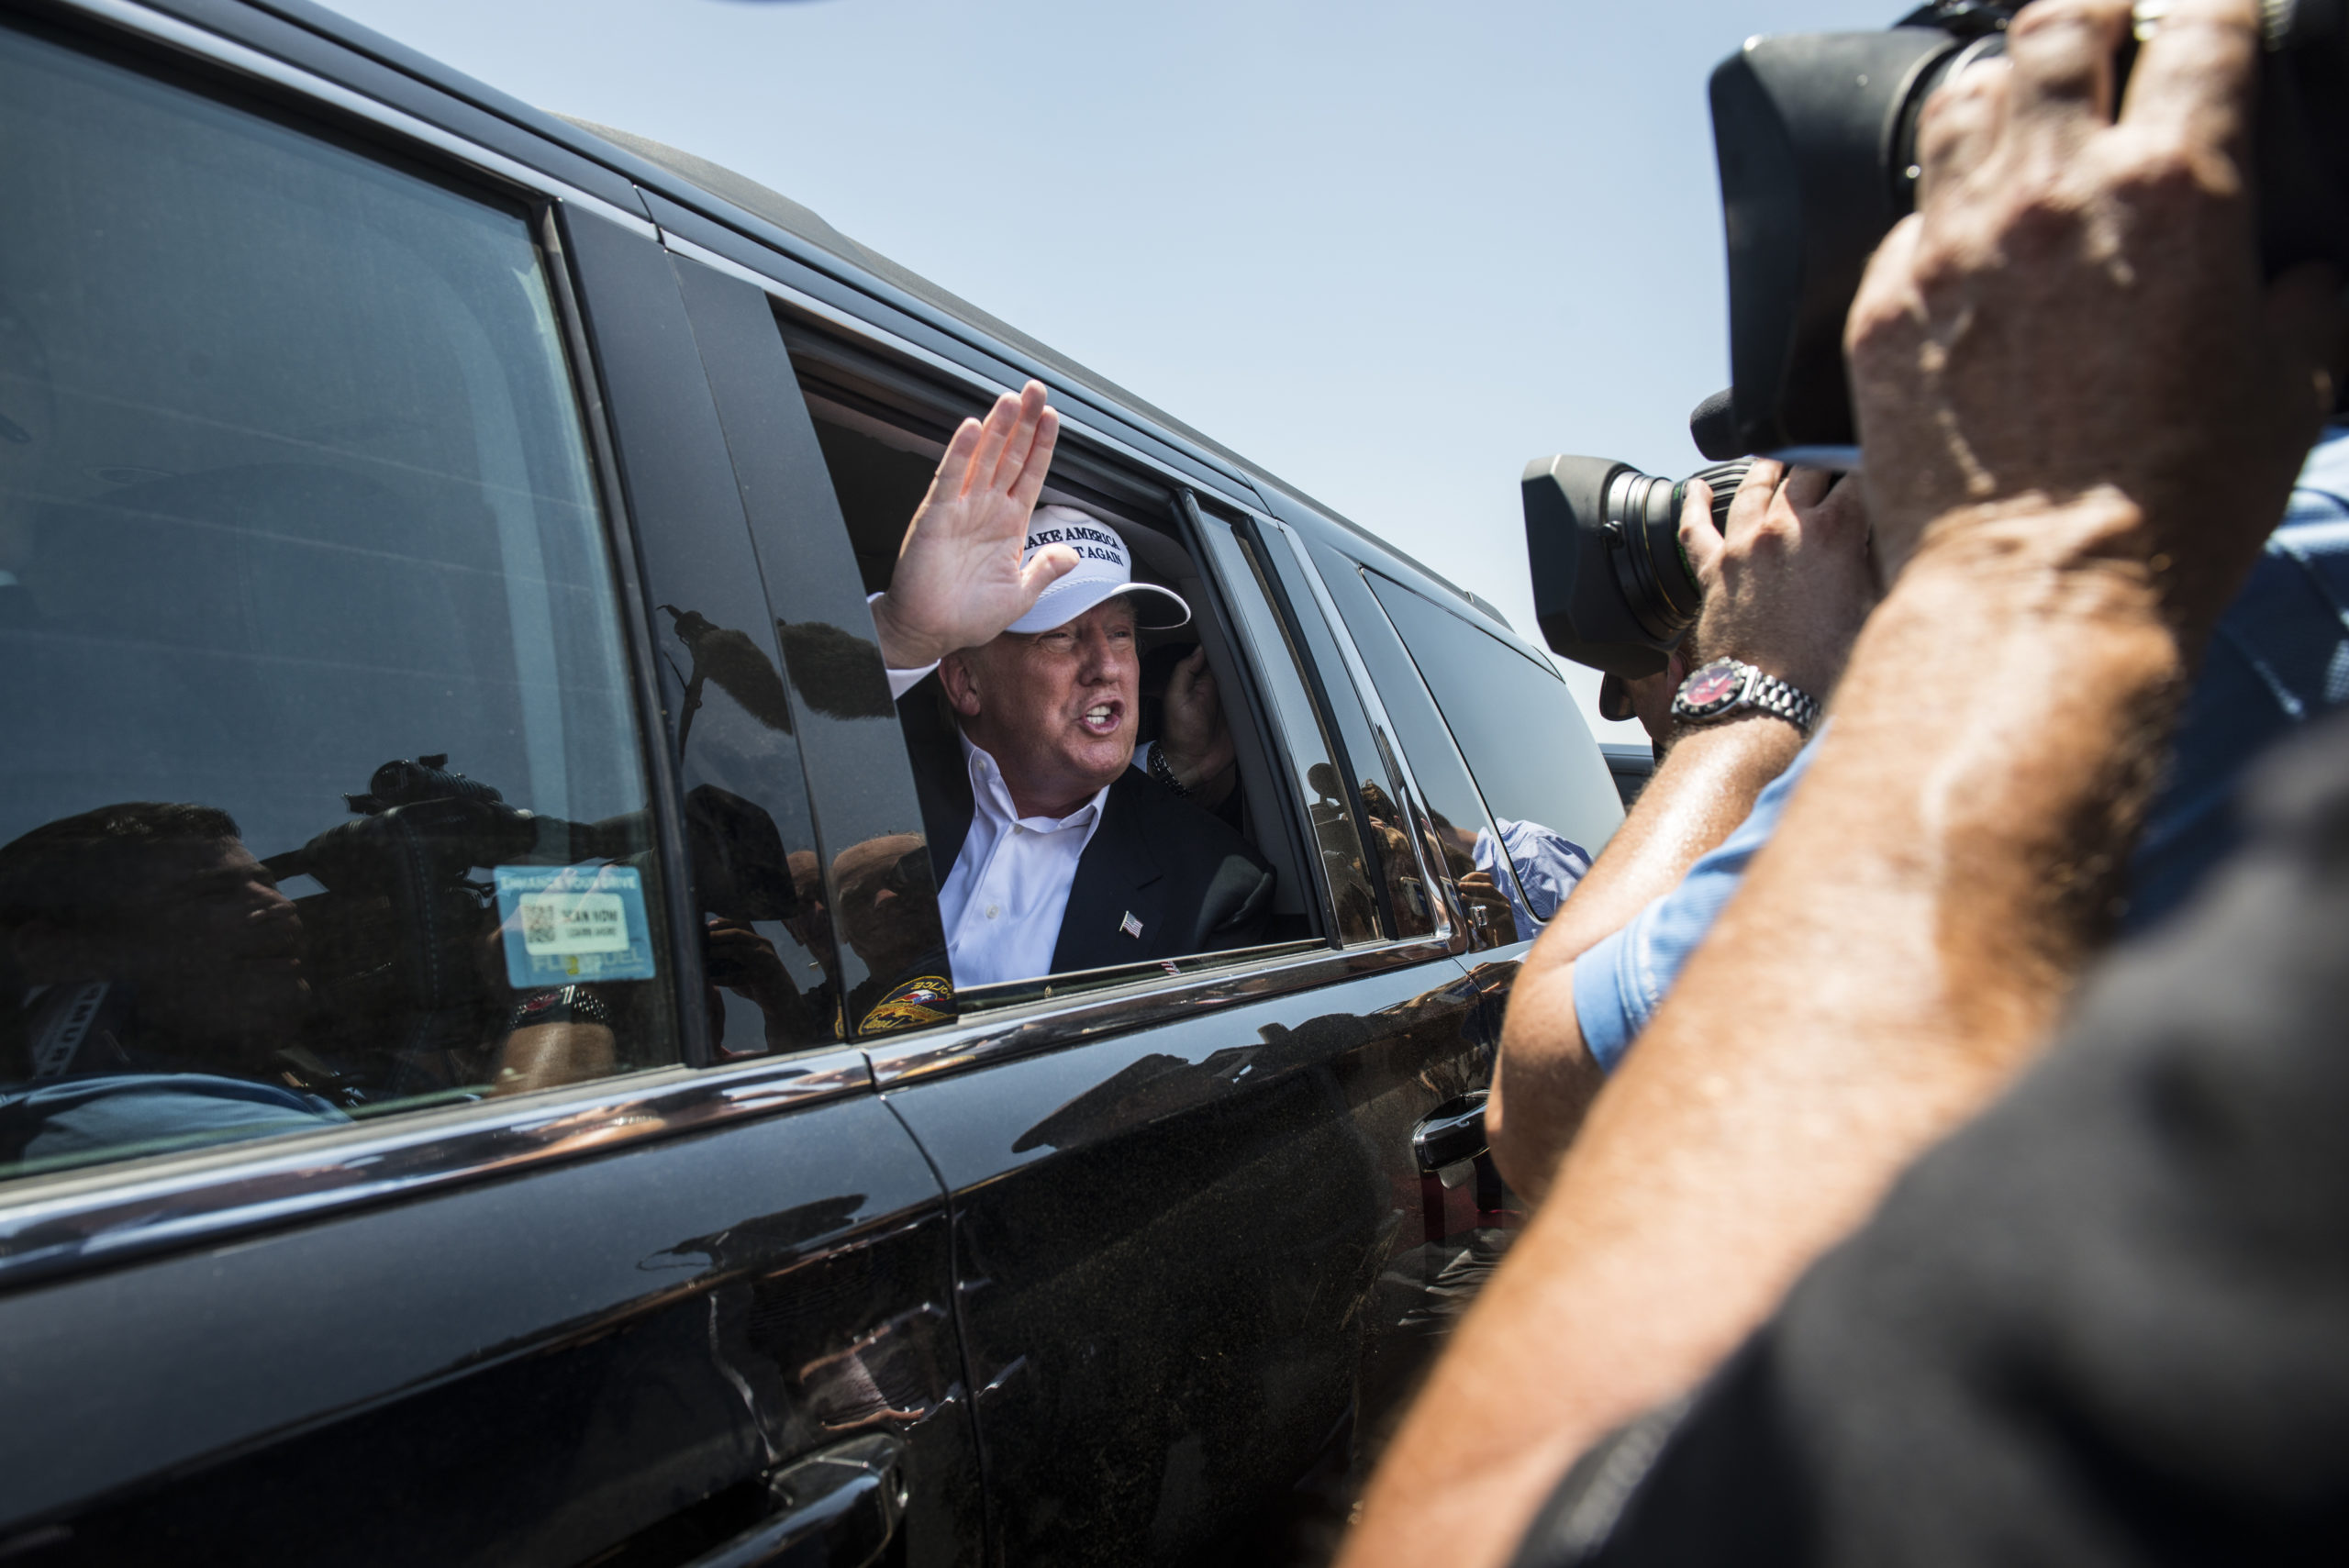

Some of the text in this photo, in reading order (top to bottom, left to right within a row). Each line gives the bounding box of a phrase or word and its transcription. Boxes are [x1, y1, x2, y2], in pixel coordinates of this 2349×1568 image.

[1024, 527, 1121, 550] AKE AMERICA
[1087, 546, 1124, 567] AGAIN
